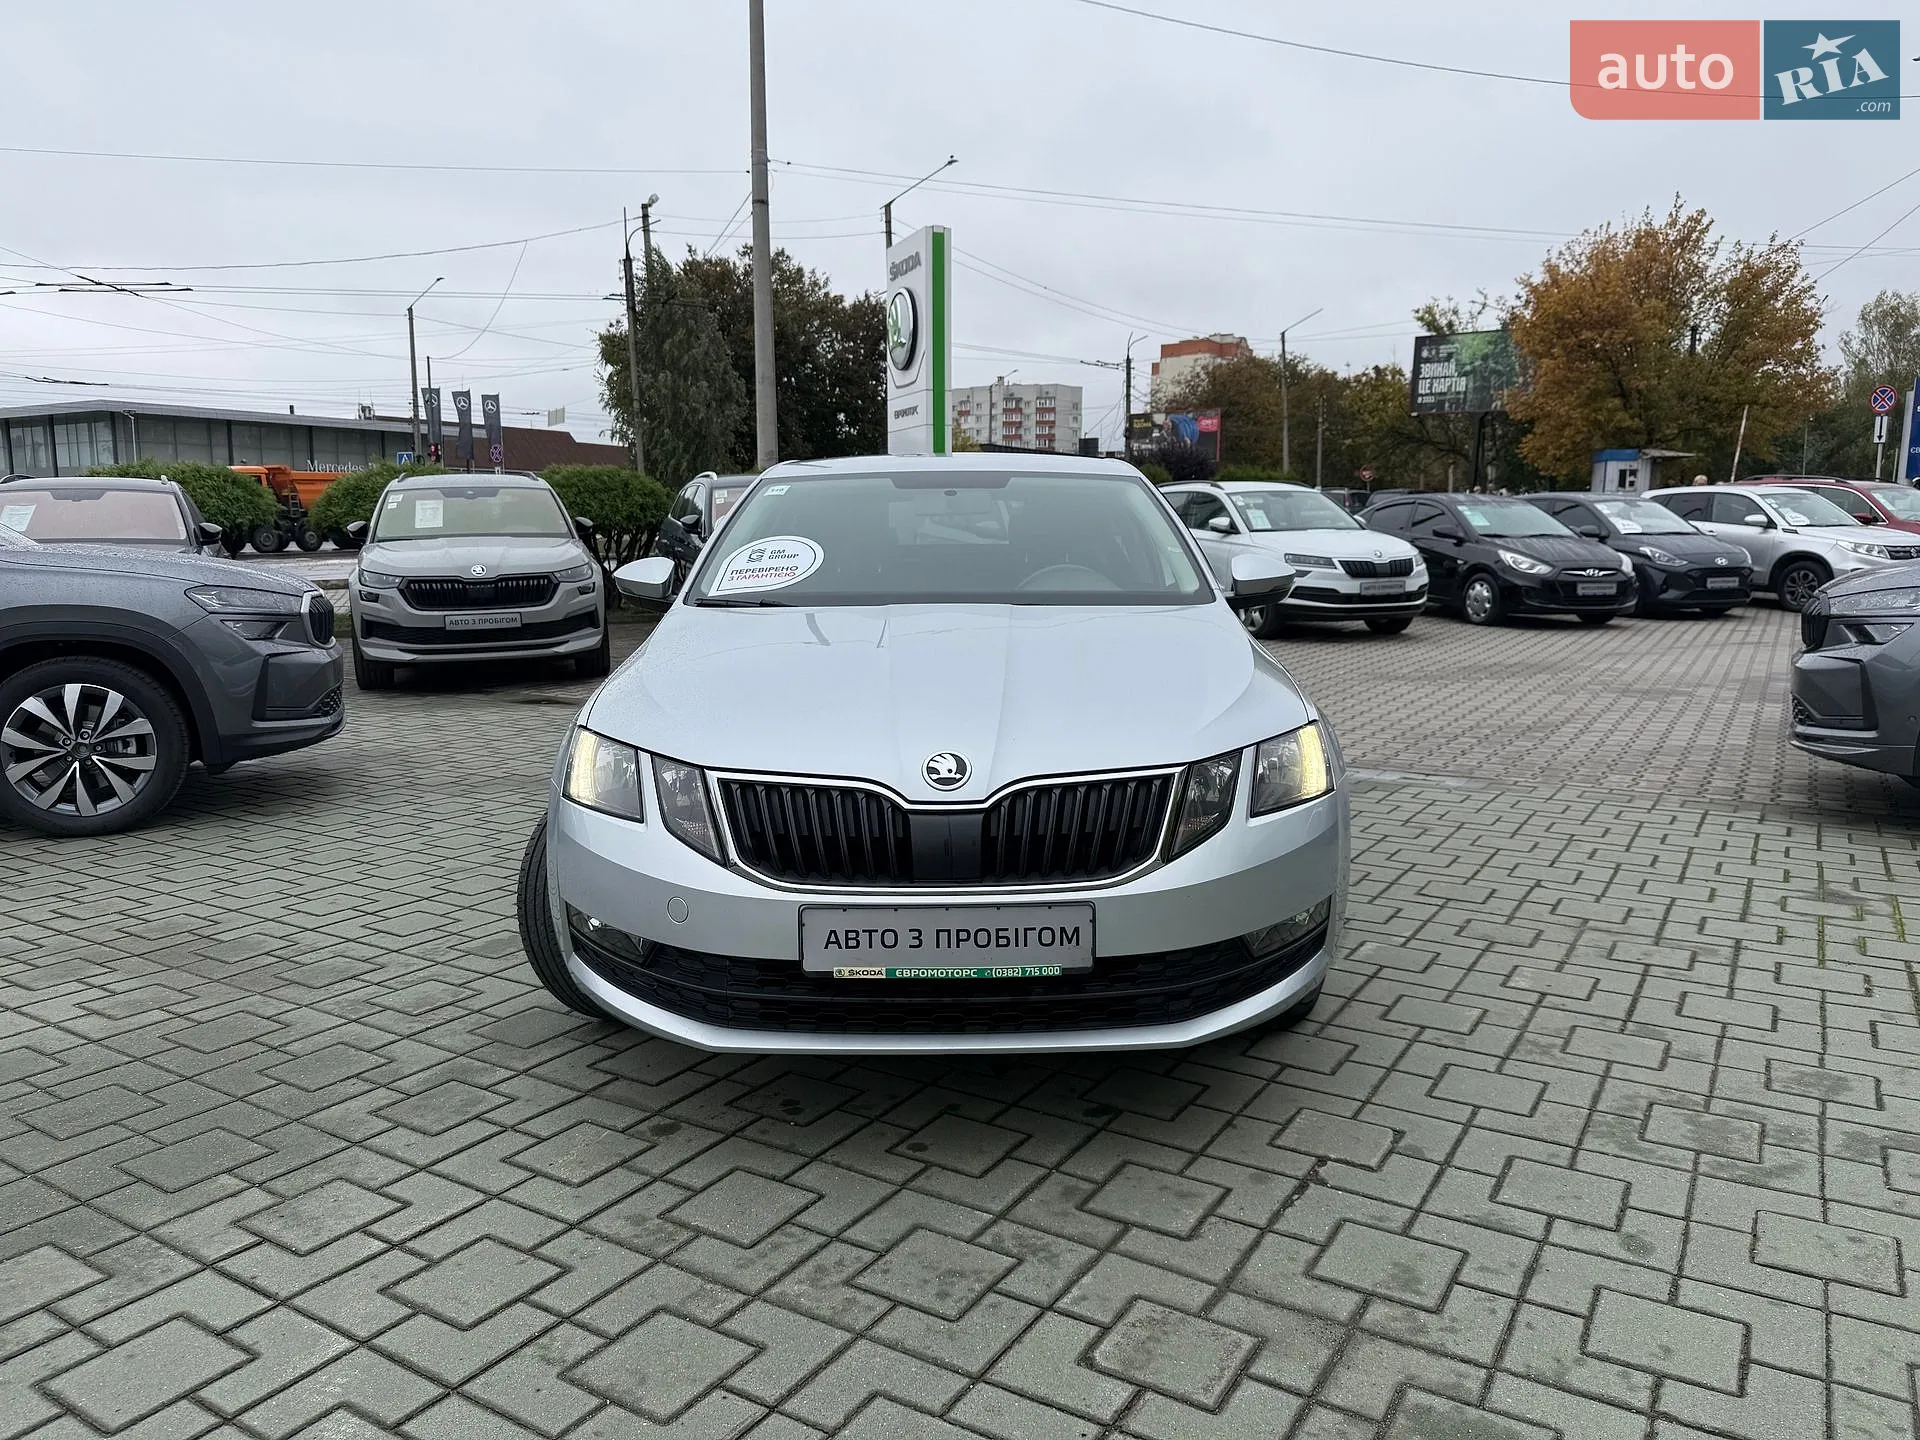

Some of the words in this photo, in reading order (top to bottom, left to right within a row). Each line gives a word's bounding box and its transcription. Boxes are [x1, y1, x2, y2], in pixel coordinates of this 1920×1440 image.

[1418, 379, 1431, 395] ЦЕ
[730, 565, 799, 576] ПЕРЕВІРЕНО
[736, 571, 797, 581] ГАРАНТІЄЮ
[478, 616, 518, 625] ПРОБІГОМ
[823, 928, 899, 950] АВТО
[908, 928, 923, 949] З
[935, 926, 1080, 949] ПРОБІГОМ
[895, 968, 978, 978] ЄВРОМОТОРС
[991, 967, 1022, 978] (0382)
[1025, 967, 1040, 976] 715
[1041, 966, 1060, 976] 000
